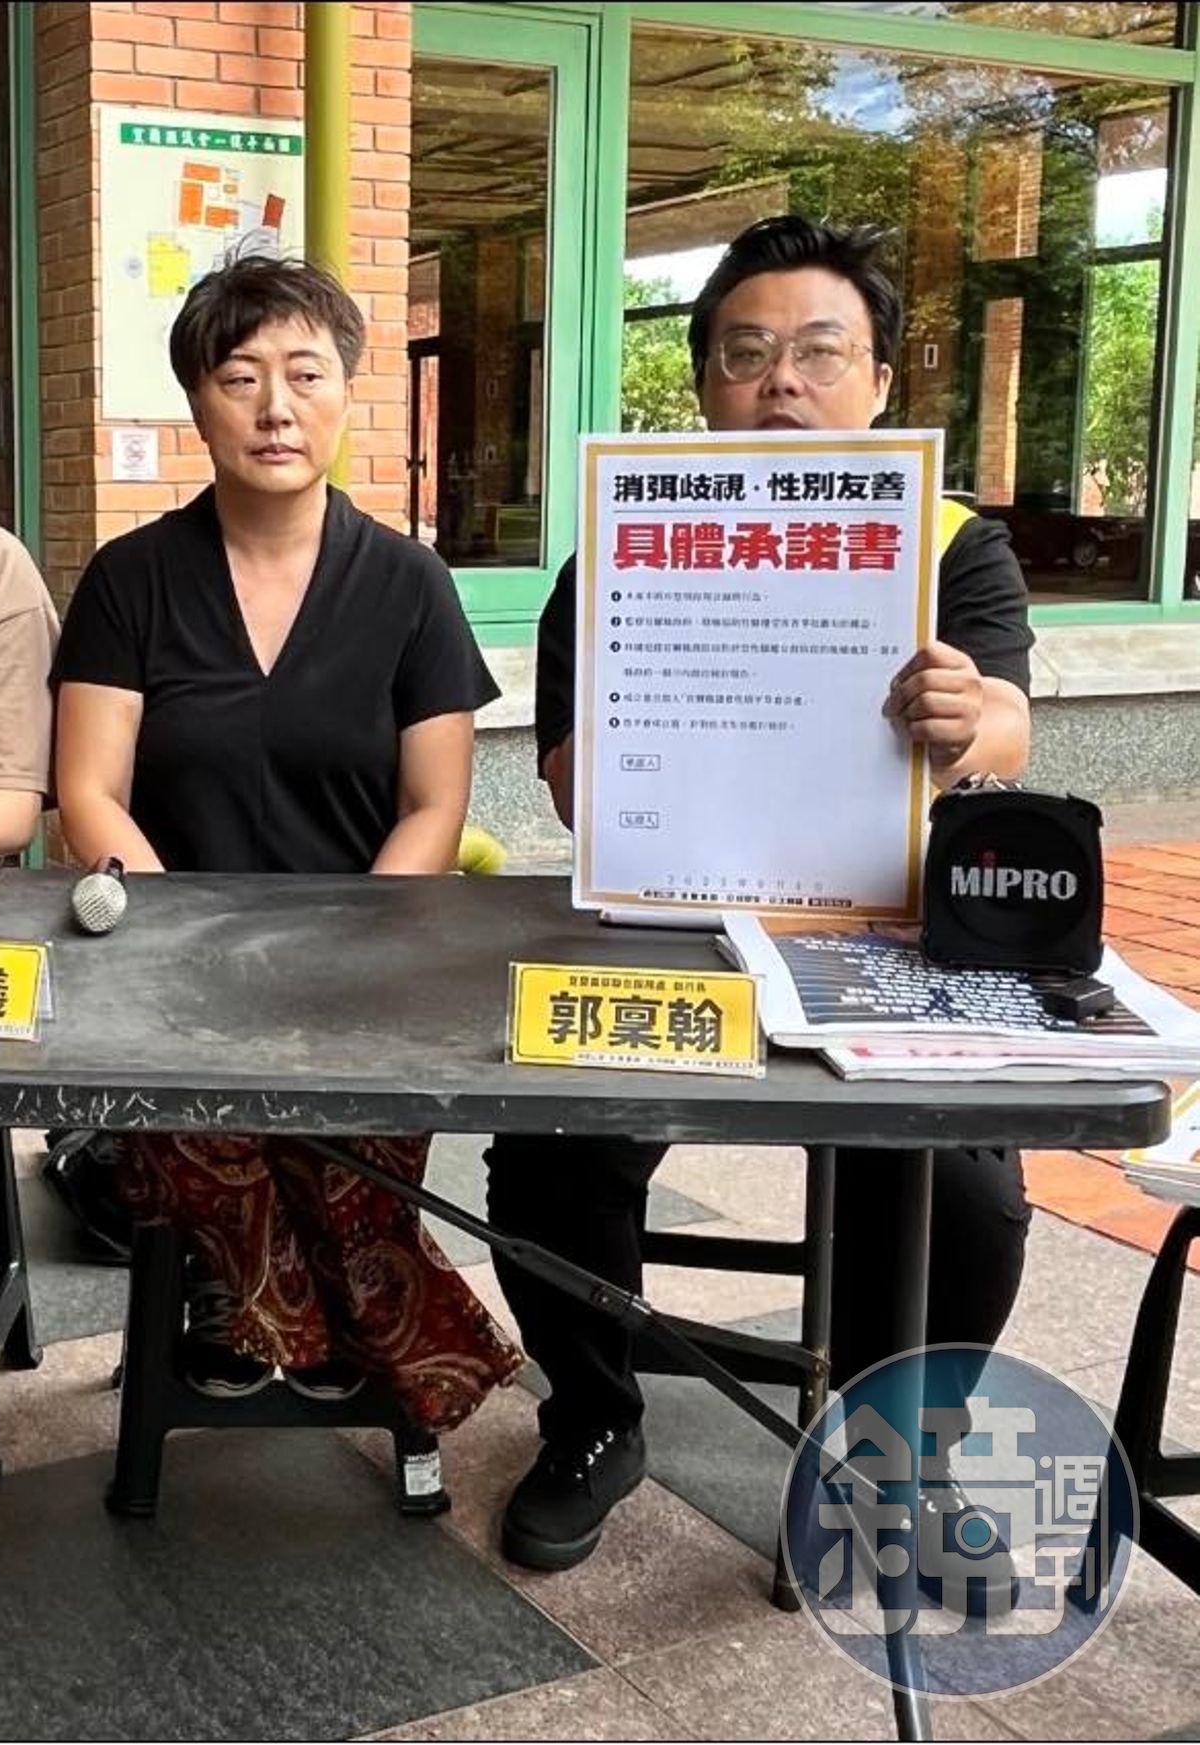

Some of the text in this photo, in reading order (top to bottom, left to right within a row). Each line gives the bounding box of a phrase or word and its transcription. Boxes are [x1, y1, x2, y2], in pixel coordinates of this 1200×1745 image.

[613, 522, 902, 571] 具體承諾書
[547, 991, 724, 1053] 郭稟翰
